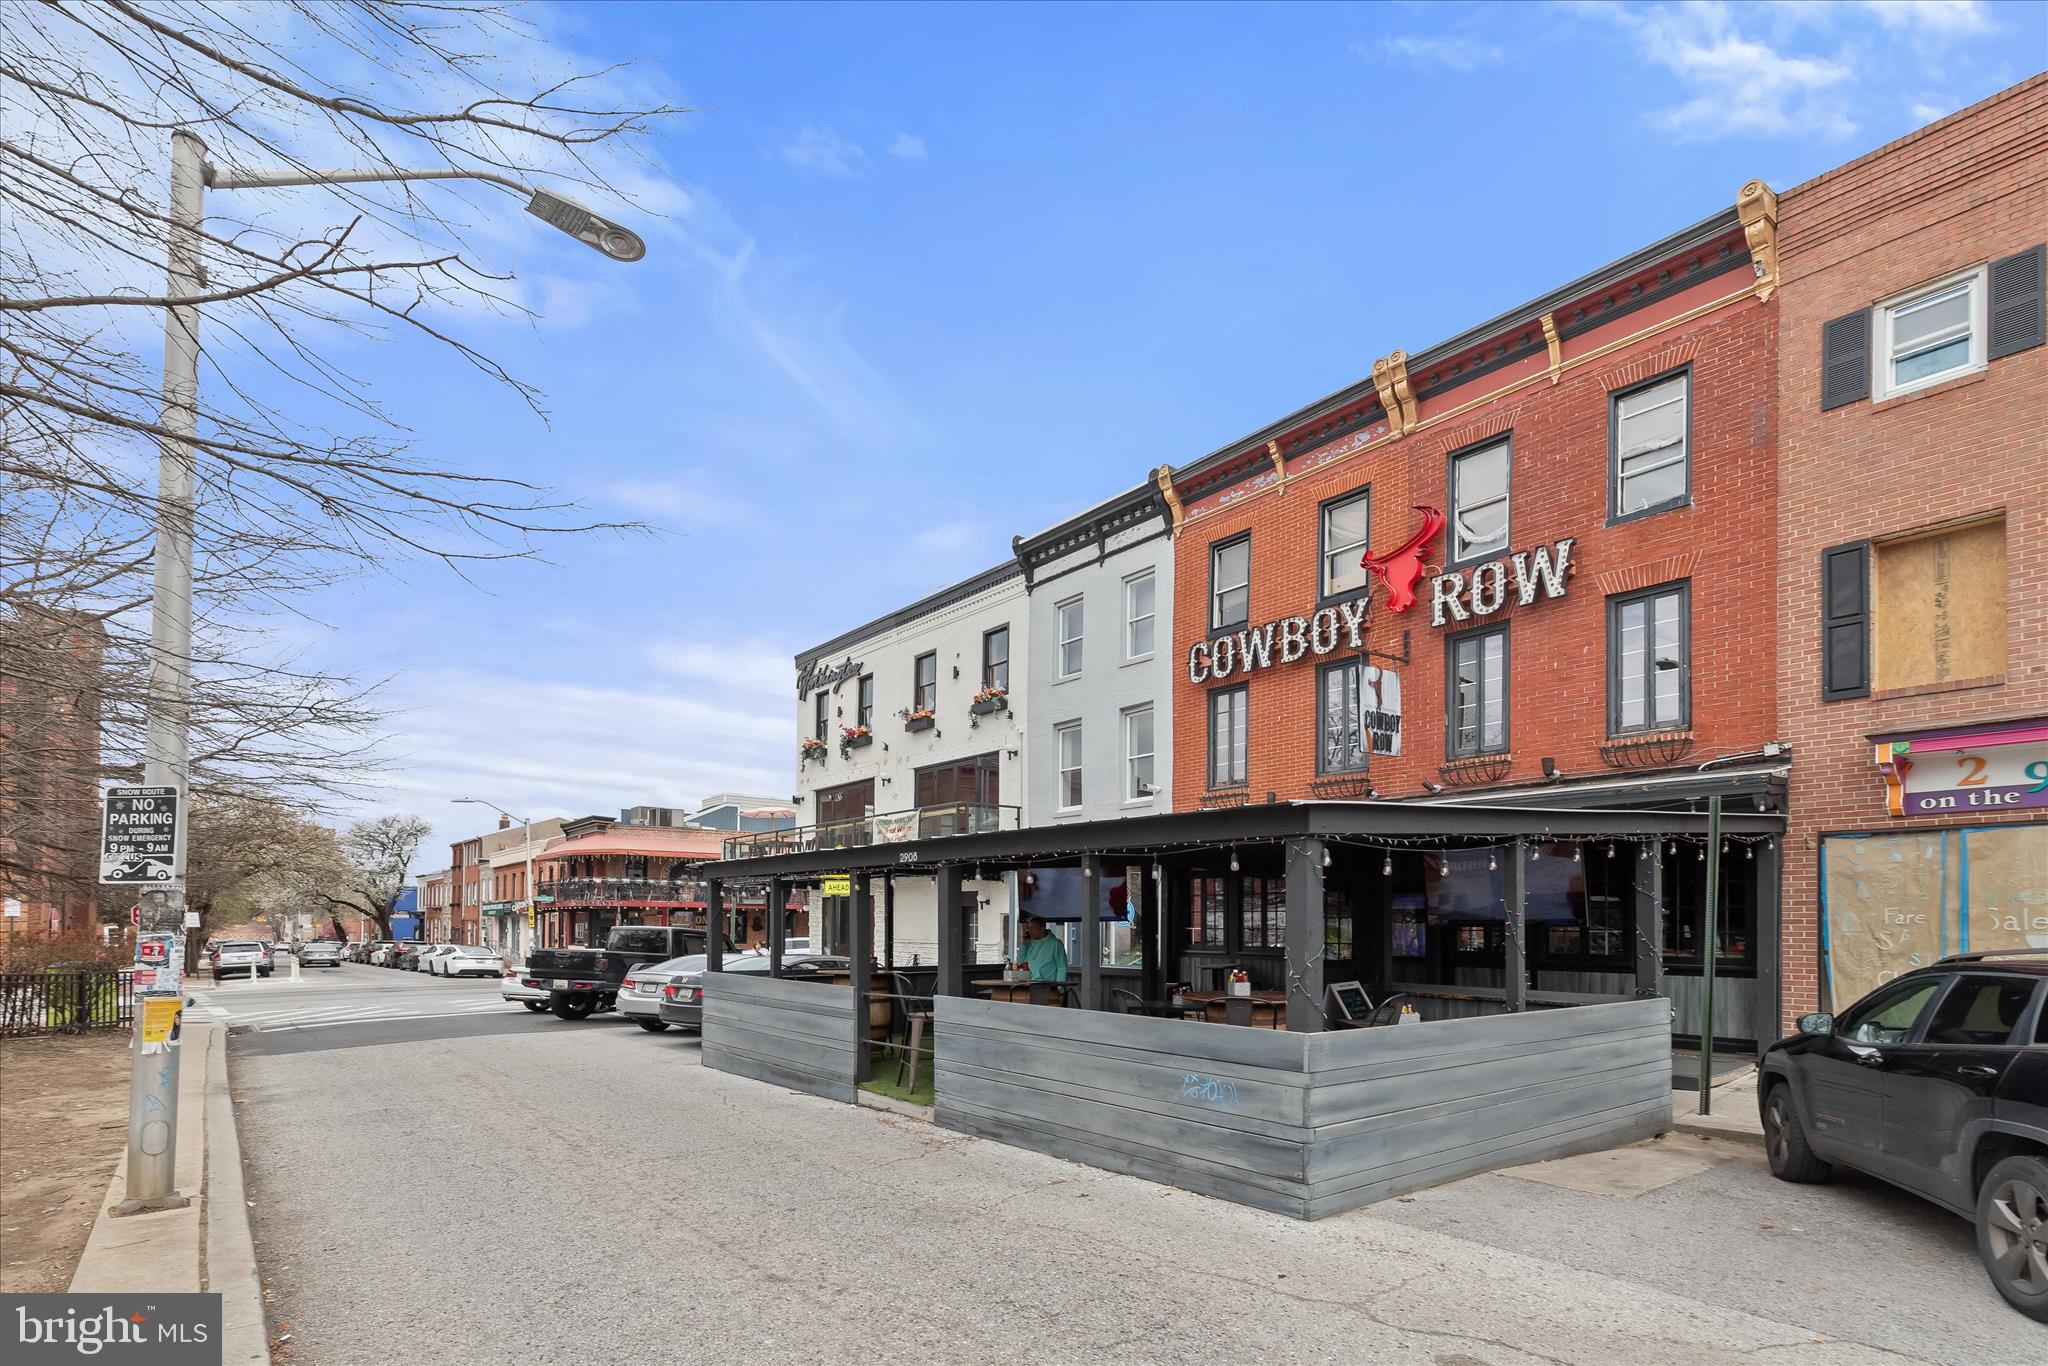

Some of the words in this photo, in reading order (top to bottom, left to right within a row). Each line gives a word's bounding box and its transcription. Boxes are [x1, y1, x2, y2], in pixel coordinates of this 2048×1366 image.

[1188, 596, 1369, 684] COWBOY
[1431, 538, 1575, 627] ROW
[1364, 710, 1401, 733] COWBOY
[1373, 731, 1393, 752] ROW
[132, 799, 155, 811] NO
[1920, 796, 1957, 809] on
[1968, 789, 2021, 805] the
[109, 813, 173, 825] PARKING
[110, 843, 118, 853] 9
[120, 845, 135, 853] PM
[147, 842, 154, 852] 9
[154, 844, 169, 852] AM
[1884, 907, 1925, 925] Fare
